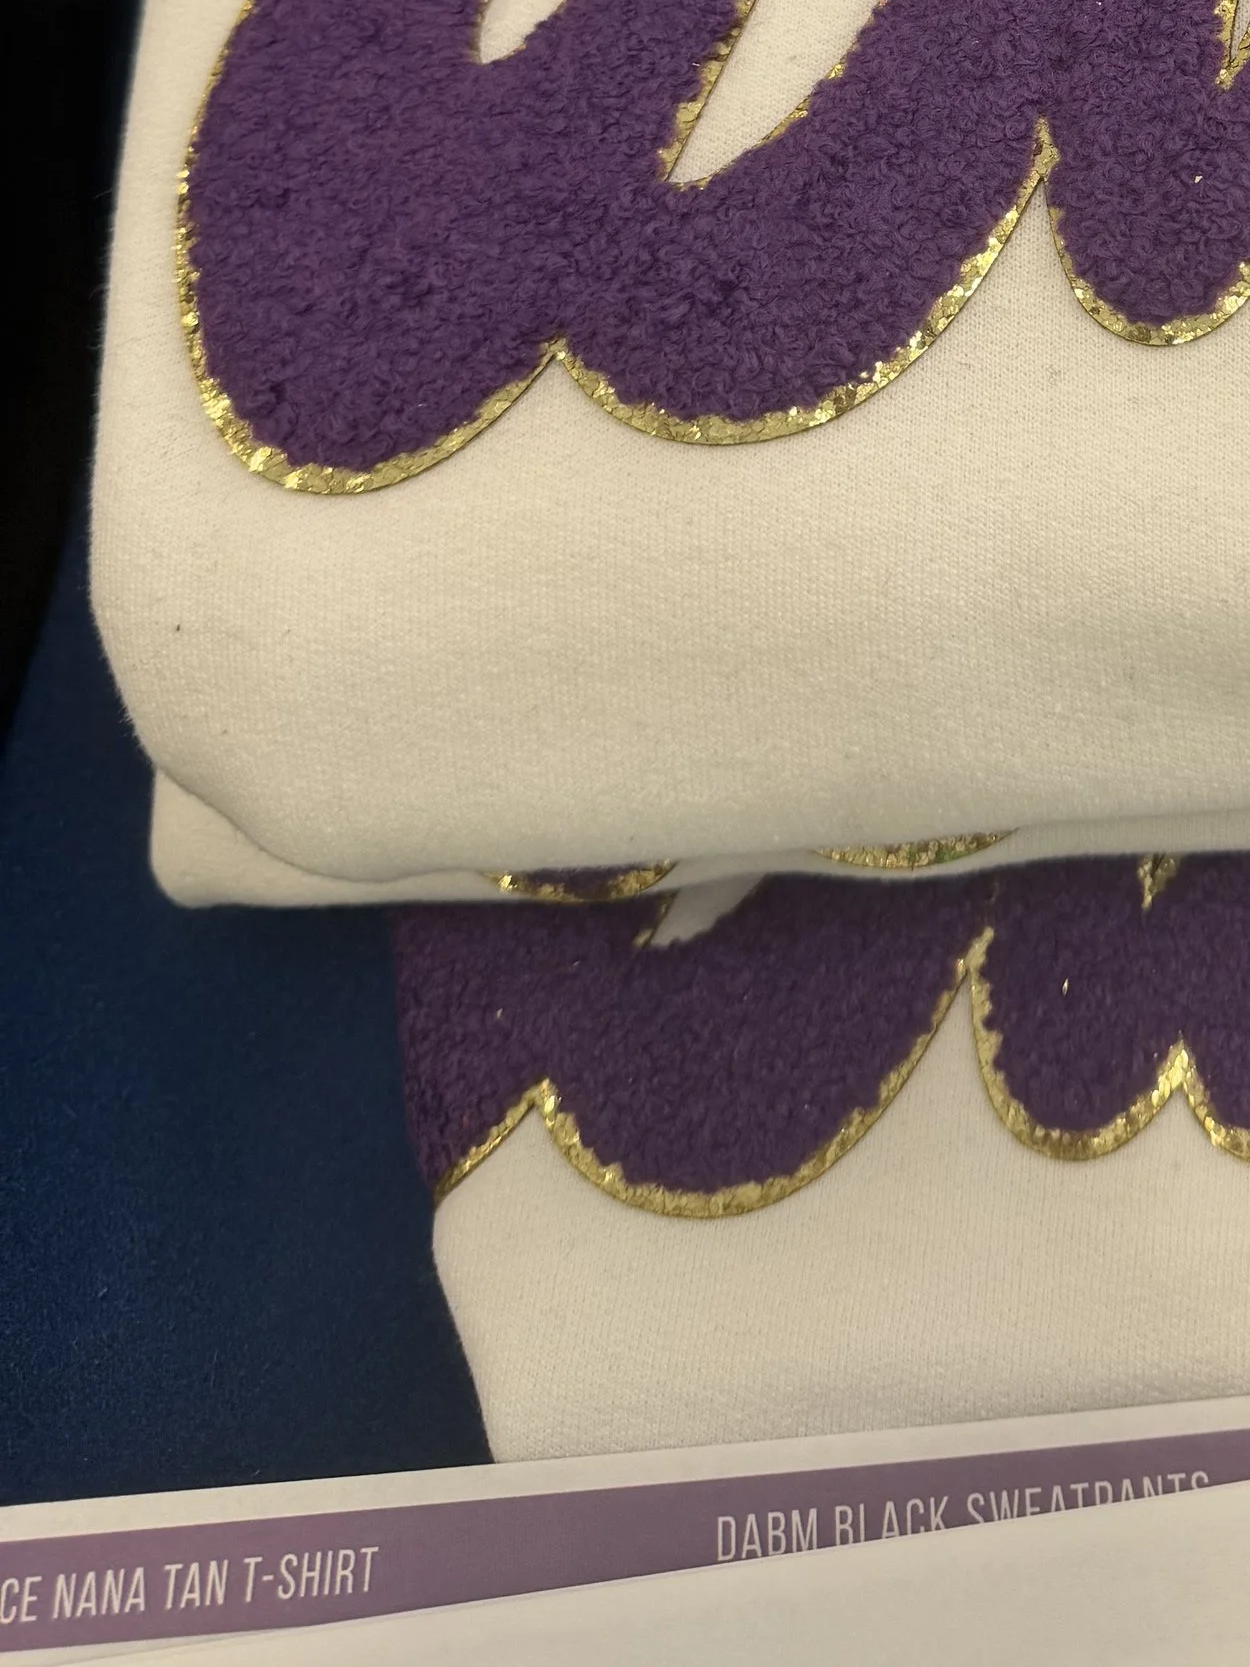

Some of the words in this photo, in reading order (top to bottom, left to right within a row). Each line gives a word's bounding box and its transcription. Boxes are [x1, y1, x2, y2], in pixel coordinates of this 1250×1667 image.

[717, 1507, 818, 1562] DABM
[52, 1566, 146, 1620] NANA
[164, 1559, 229, 1610] TAN
[242, 1546, 380, 1603] T-SHIRT
